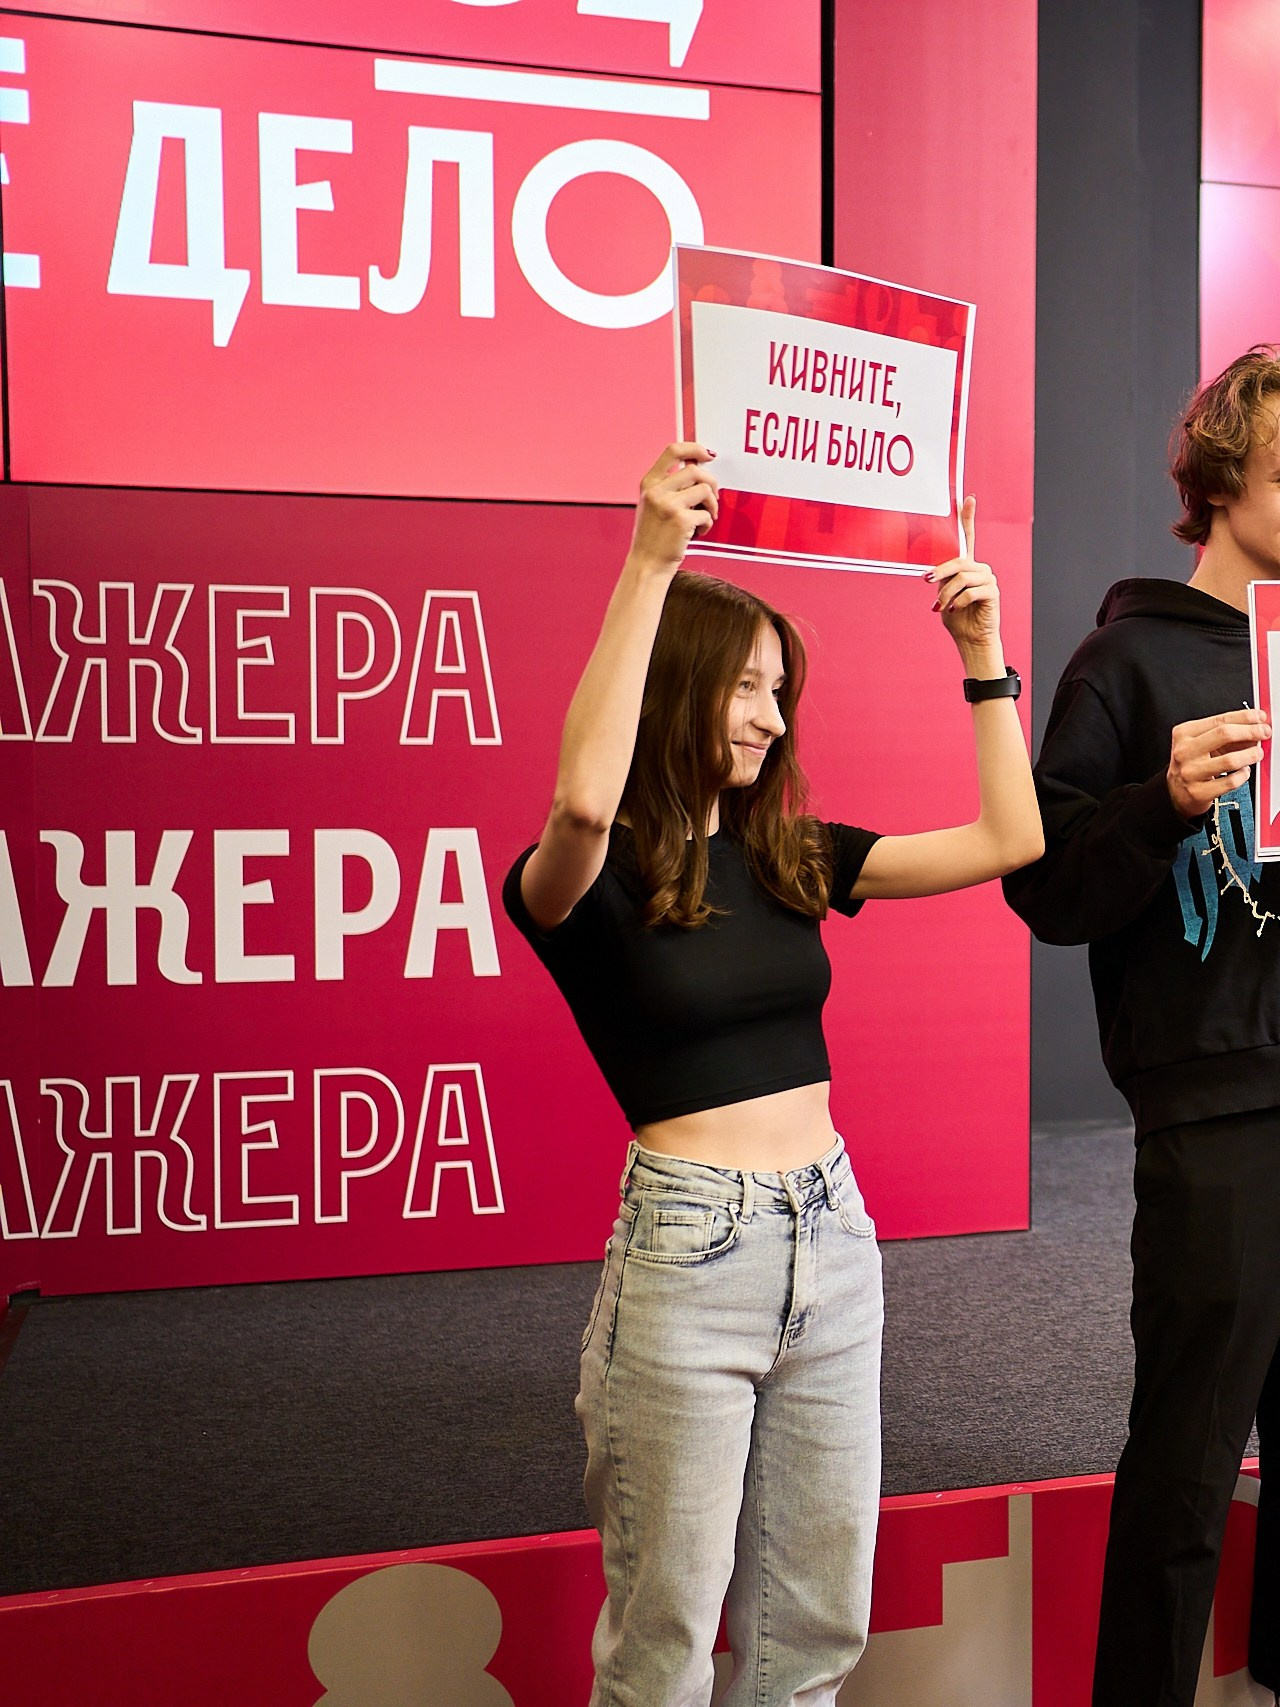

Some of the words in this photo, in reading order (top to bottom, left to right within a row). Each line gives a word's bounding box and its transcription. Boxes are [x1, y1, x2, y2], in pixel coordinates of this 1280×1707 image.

[107, 100, 705, 348] ДЕЛО
[768, 340, 902, 419] КИВНИТЕ,
[744, 408, 820, 463] ЕСЛИ
[826, 422, 914, 477] БЫЛО
